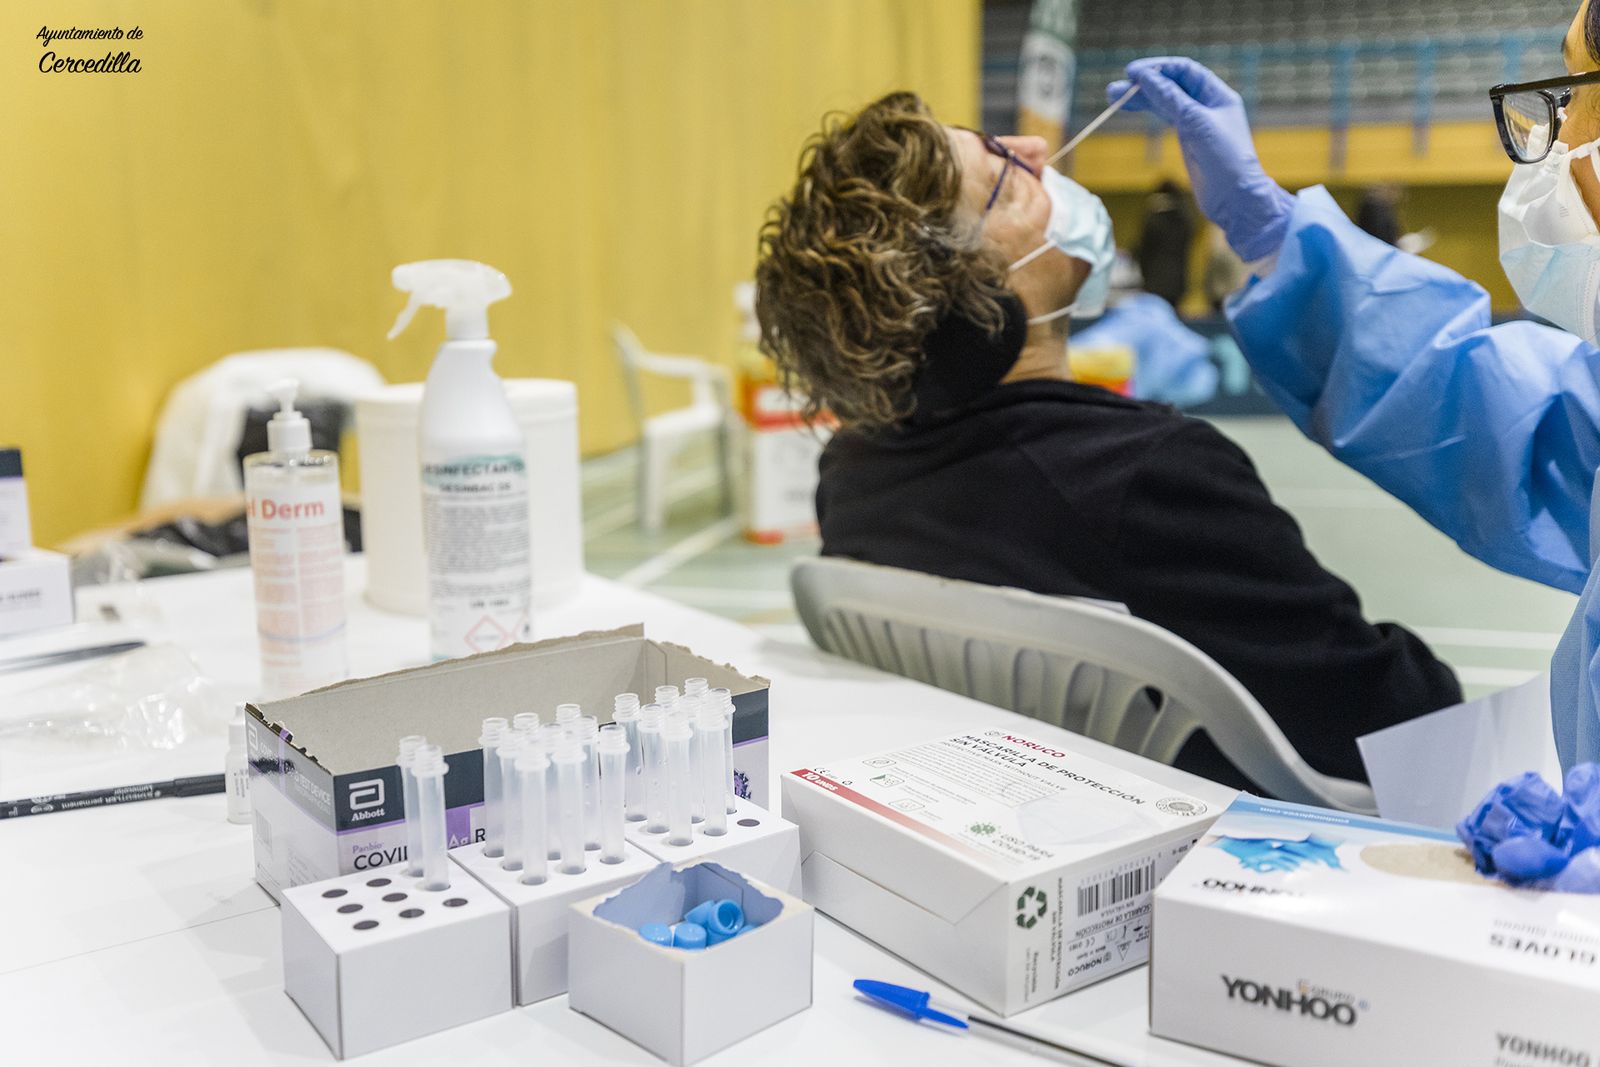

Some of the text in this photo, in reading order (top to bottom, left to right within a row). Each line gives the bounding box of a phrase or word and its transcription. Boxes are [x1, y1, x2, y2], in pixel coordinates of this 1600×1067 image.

[261, 498, 324, 520] Derm
[950, 738, 969, 747] SIN
[1001, 734, 1066, 759] NORUCO
[801, 770, 818, 782] 10
[961, 735, 1036, 763] MASCARILLA
[1037, 760, 1058, 772] DE
[1056, 769, 1146, 806] PROTECCIÓN
[61, 796, 103, 810] permanent
[351, 808, 385, 822] Abbott
[352, 842, 383, 855] Panbio
[354, 846, 407, 871] COVI
[1075, 917, 1114, 938] PROTECCIÓN
[1489, 933, 1597, 966] GLOVES
[1067, 956, 1103, 977] NORUCO
[1221, 974, 1359, 1027] YONHOO
